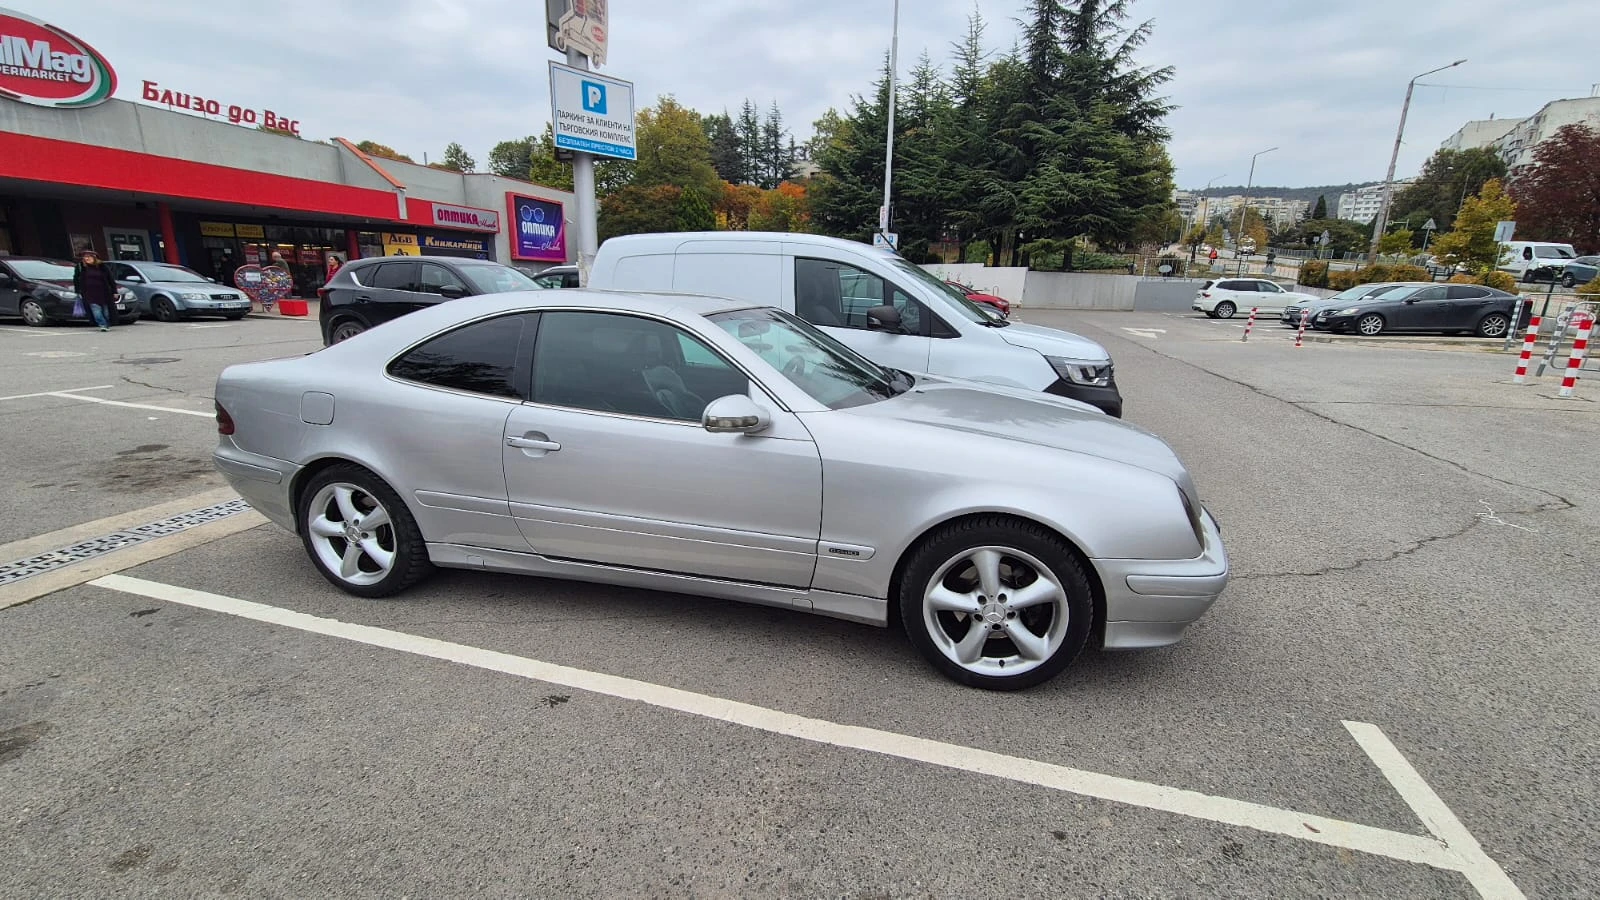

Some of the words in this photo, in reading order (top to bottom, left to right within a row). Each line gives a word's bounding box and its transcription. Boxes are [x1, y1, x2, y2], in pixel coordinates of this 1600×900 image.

[0, 65, 72, 82] ERMARKET
[142, 80, 220, 115] Близо
[228, 105, 256, 123] до
[264, 109, 300, 134] Вас
[557, 109, 585, 123] ПАРКИНГ
[587, 117, 595, 125] ЗА
[596, 118, 622, 131] КЛИЕНТИ
[623, 124, 631, 132] НА
[559, 122, 598, 137] ТЪРГОВСКИЯ
[599, 130, 631, 144] КОМПЛЕКС
